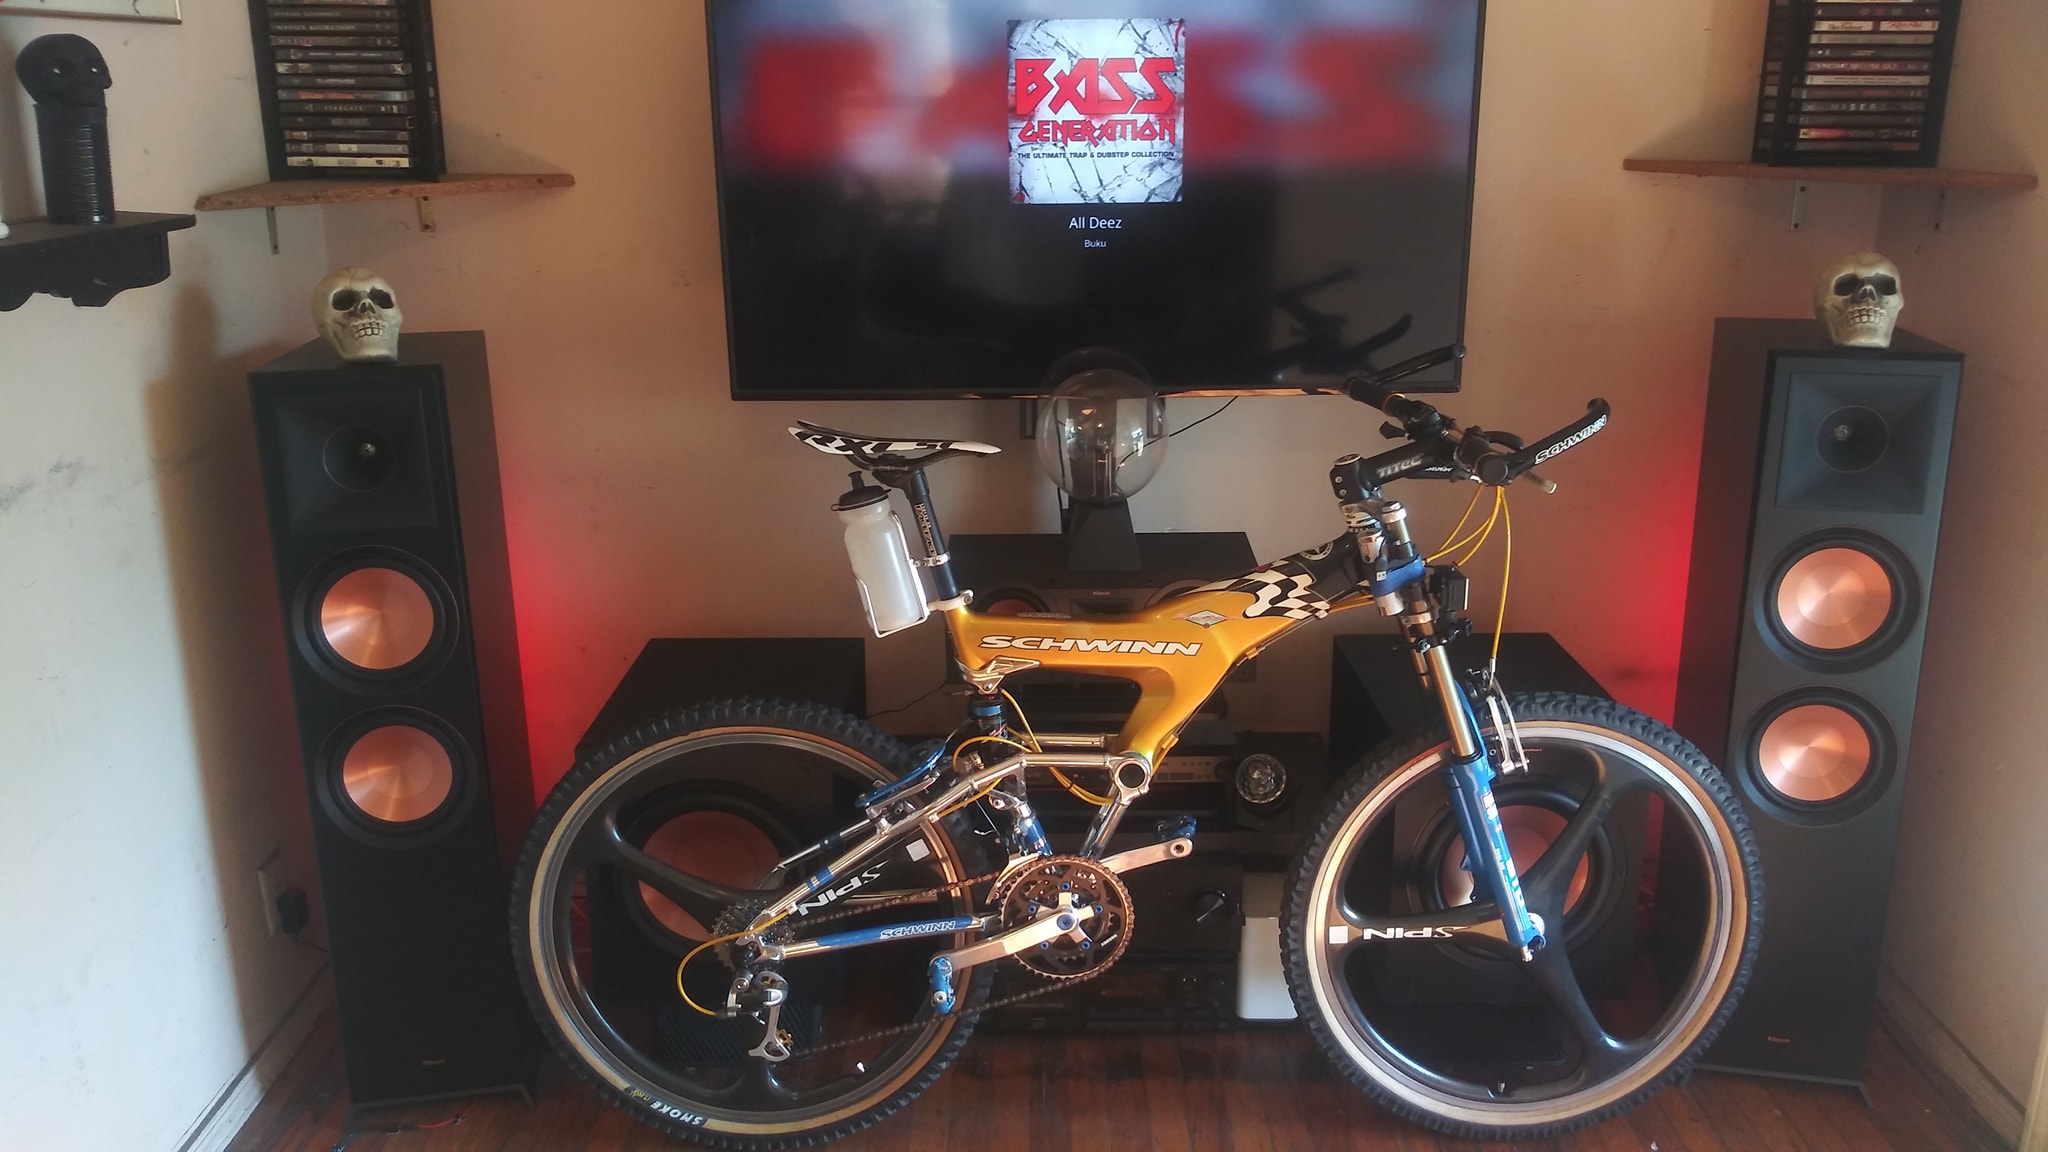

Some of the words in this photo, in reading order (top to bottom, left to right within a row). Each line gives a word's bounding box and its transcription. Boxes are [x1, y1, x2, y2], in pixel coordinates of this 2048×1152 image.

[1015, 57, 1176, 115] BASS
[1017, 118, 1176, 147] GENERATION
[1017, 152, 1031, 160] THE
[1068, 216, 1085, 230] All
[1089, 217, 1123, 230] Deez
[1084, 239, 1107, 249] Buku
[1535, 414, 1608, 465] SCHWINN
[978, 635, 1203, 657] SCHWINN
[879, 920, 957, 940] SCHWINN
[650, 1100, 704, 1126] SMOKE
